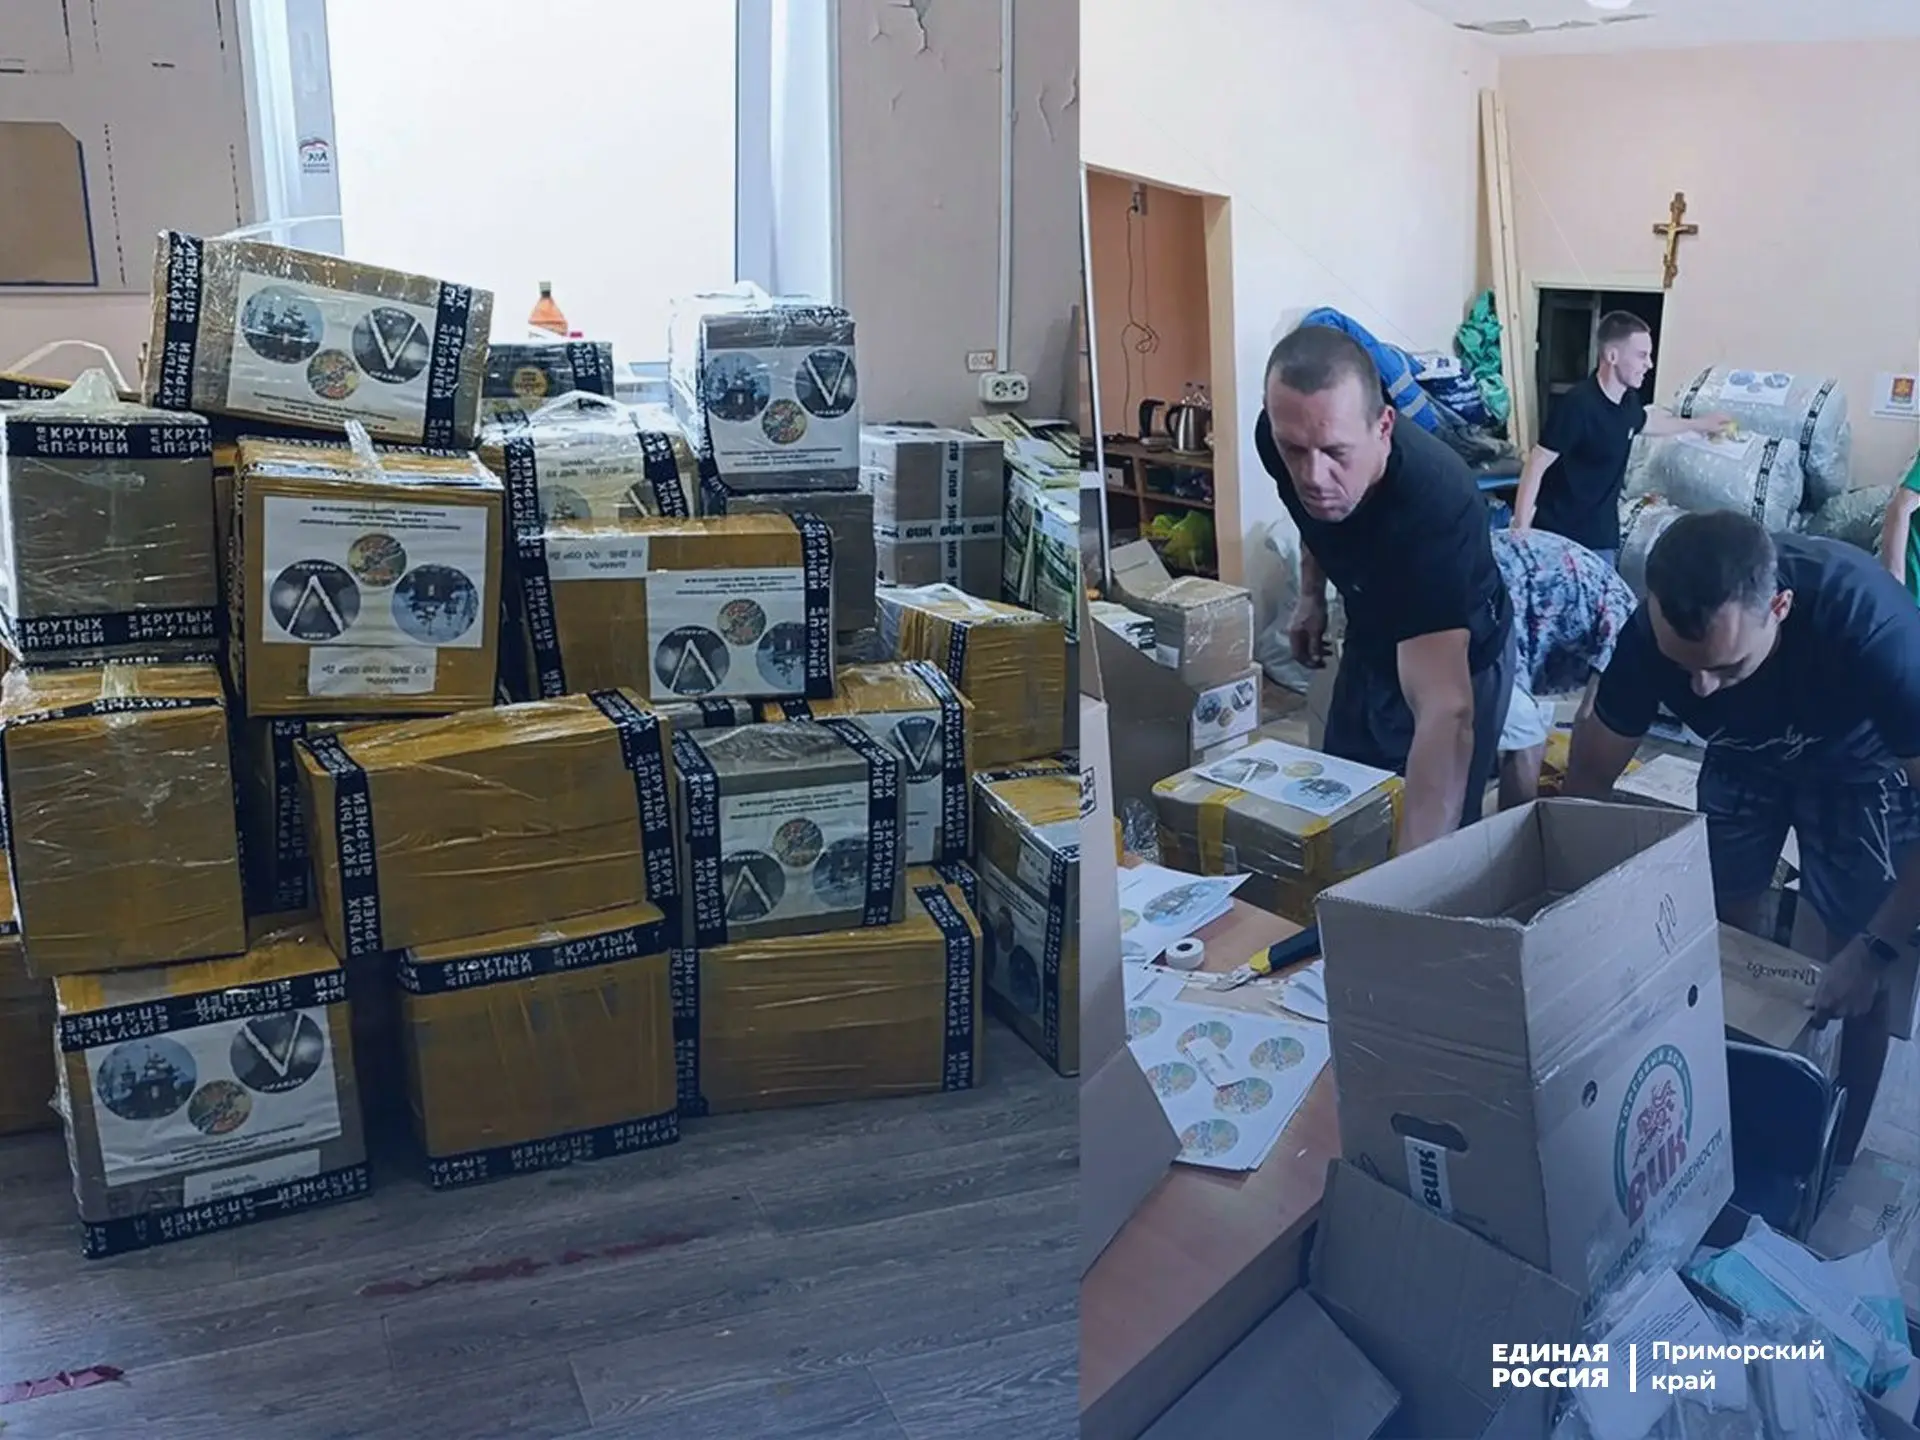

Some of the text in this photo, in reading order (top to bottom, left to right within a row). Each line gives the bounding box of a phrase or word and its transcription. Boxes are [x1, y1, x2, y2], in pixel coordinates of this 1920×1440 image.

[51, 427, 128, 441] КРУТЫХ
[26, 618, 103, 634] КРУТЫХ
[140, 610, 213, 626] КРУТЫХ
[340, 795, 358, 865] КРУТЫХ
[349, 897, 364, 955] РУТЫХ
[565, 930, 636, 957] КРУТЫХ
